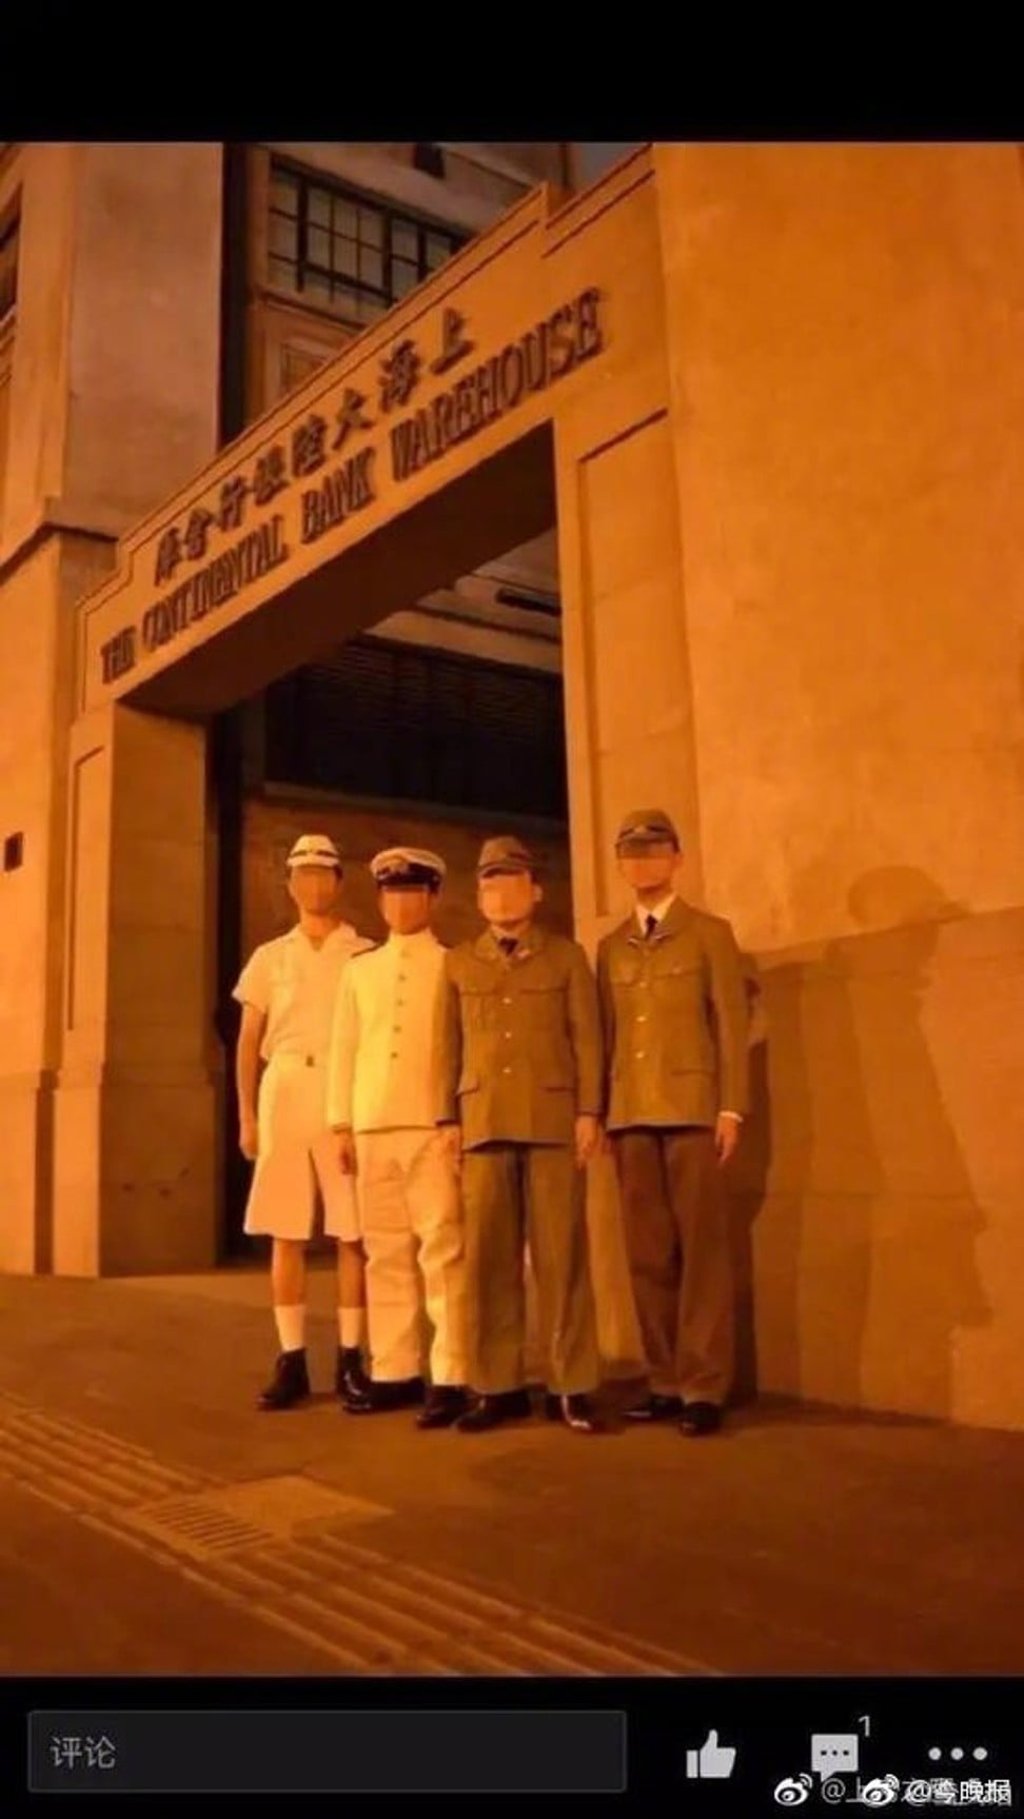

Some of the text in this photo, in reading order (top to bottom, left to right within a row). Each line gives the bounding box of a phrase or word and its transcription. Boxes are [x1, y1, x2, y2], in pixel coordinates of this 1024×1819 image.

[101, 287, 605, 684] THE CONTINENTAL BANK WAREHOUSE
